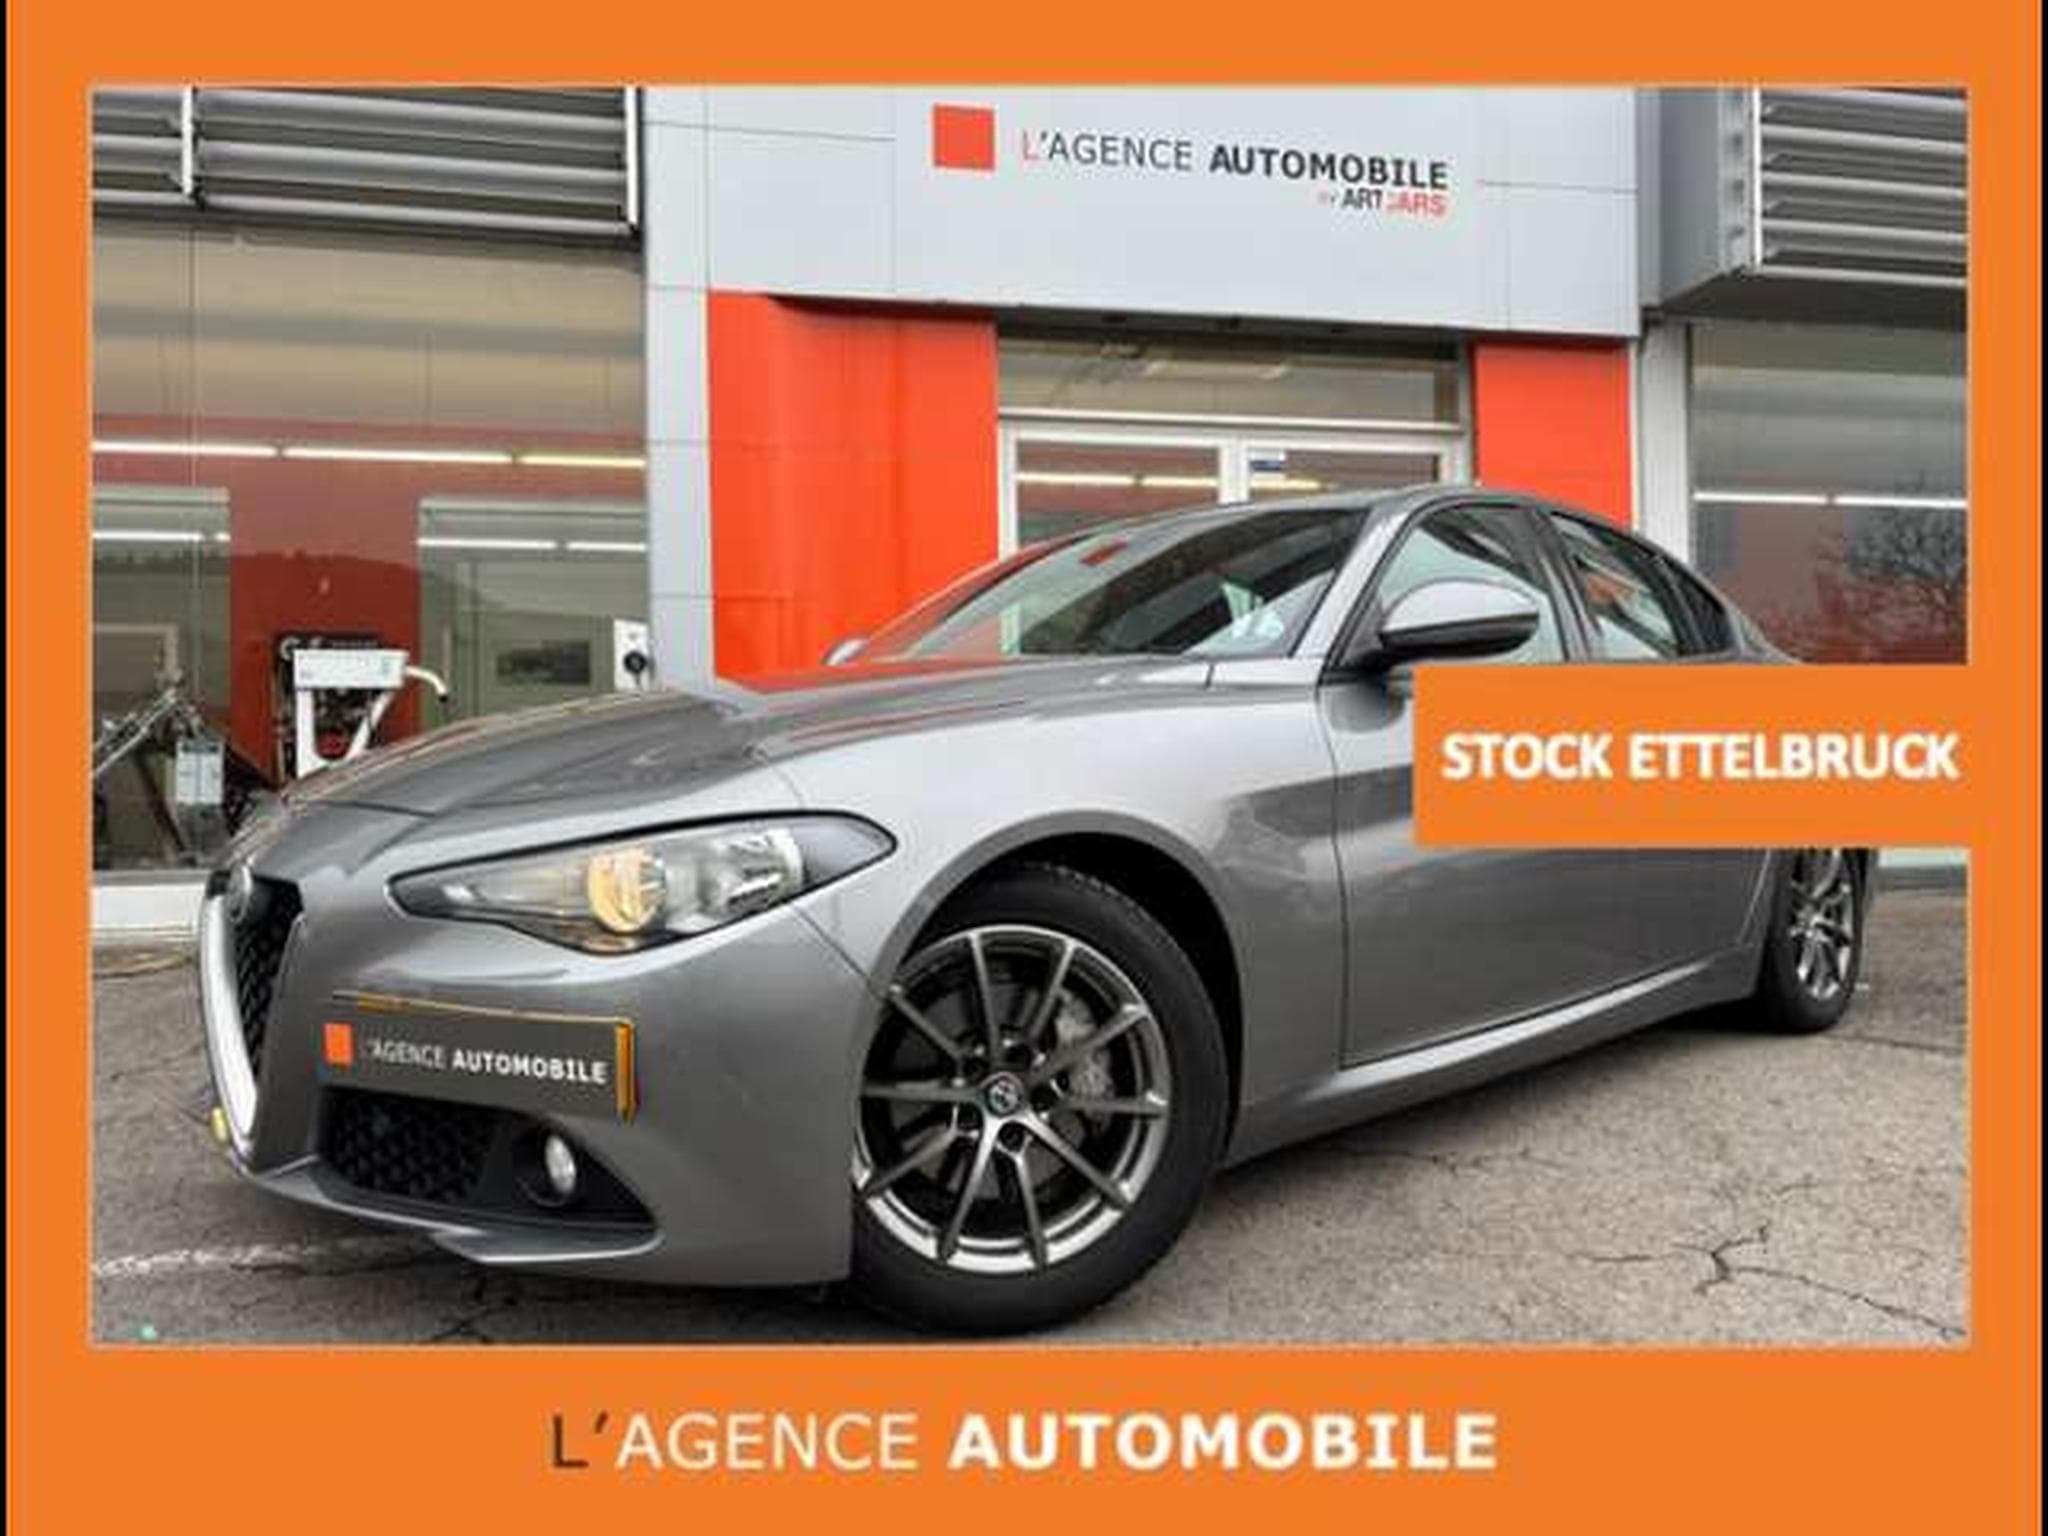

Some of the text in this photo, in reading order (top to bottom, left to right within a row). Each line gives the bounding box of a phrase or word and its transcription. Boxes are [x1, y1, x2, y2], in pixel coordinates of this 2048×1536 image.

[1021, 130, 1449, 191] L'AGENCE AUTOMOBILE
[452, 1047, 608, 1085] AUTOMOBILE
